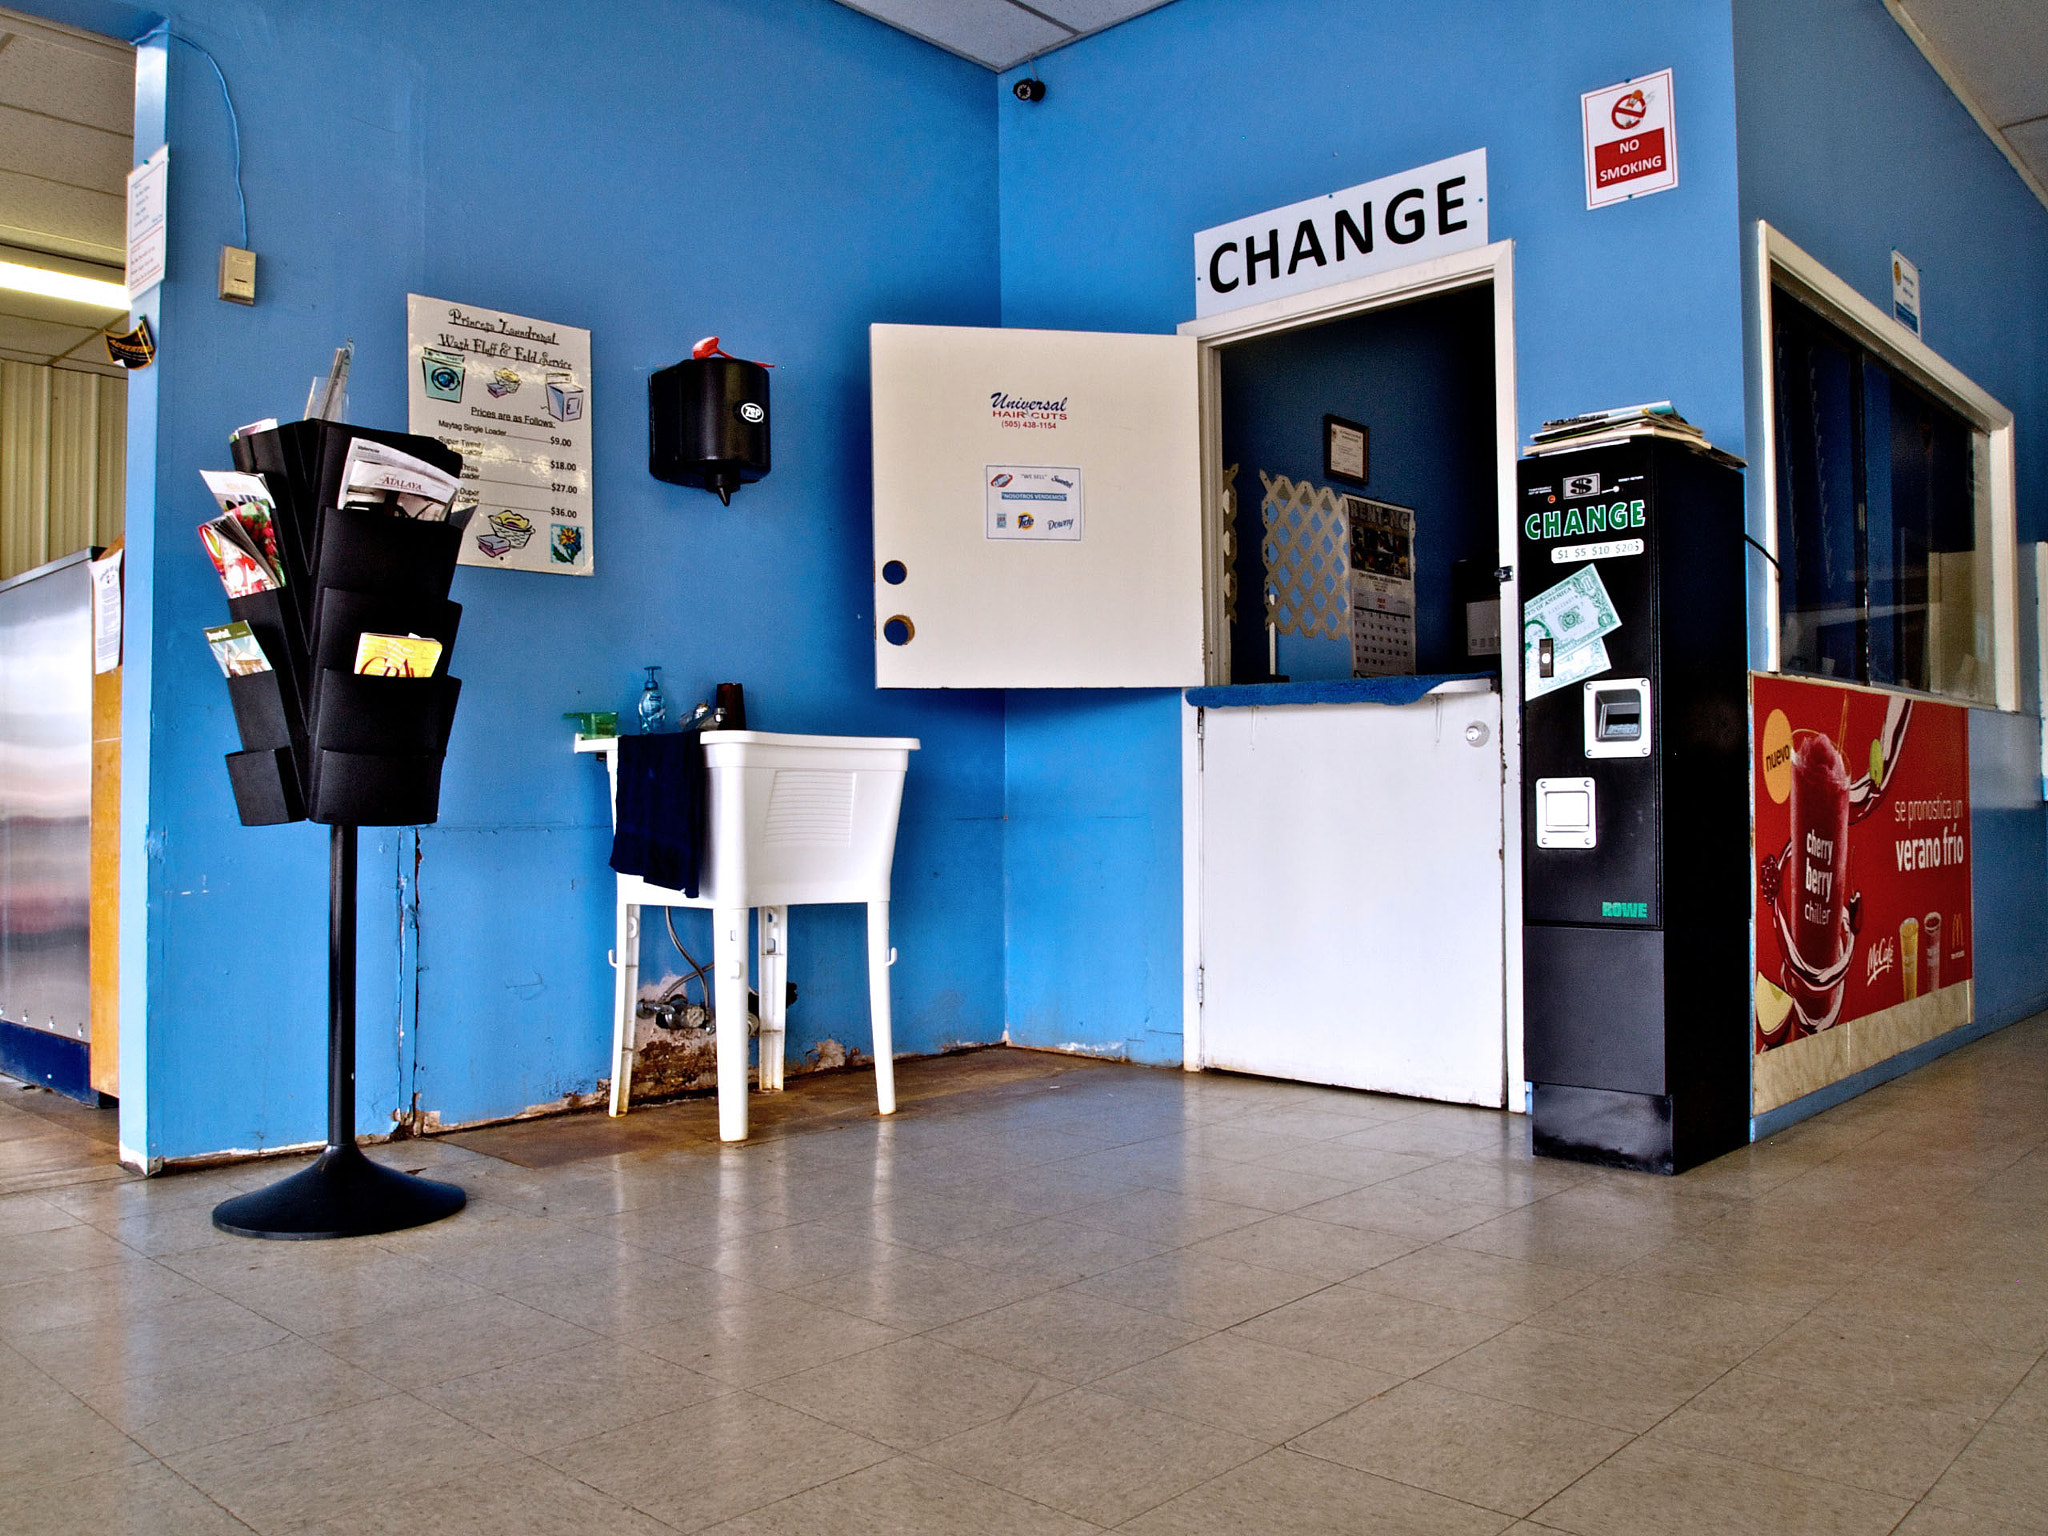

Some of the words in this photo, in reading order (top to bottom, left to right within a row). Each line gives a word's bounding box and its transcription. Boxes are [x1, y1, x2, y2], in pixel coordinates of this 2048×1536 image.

[1619, 139, 1640, 154] NO
[1599, 155, 1662, 182] SMOKING
[1209, 176, 1468, 293] CHANGE
[990, 392, 1067, 411] Universal
[471, 406, 496, 420] Prices
[497, 411, 512, 423] are
[512, 415, 523, 425] as
[523, 415, 556, 429] Follows:
[992, 410, 1025, 419] HAIR
[1030, 411, 1067, 420] CUTS
[438, 420, 463, 432] Maytag
[463, 424, 484, 435] Single
[484, 427, 507, 437] Loader
[549, 436, 572, 448] $9.00
[1001, 420, 1021, 430] (505)
[550, 460, 577, 472] $18.00
[382, 476, 422, 490] ATALAYA
[551, 483, 578, 495] $27.00
[550, 507, 577, 519] $36.00
[1018, 514, 1034, 529] Tide
[1525, 500, 1646, 540] CHANGE
[1047, 518, 1075, 531] Downy
[1557, 549, 1569, 560] $1
[1574, 547, 1587, 558] $5
[1592, 545, 1610, 556] $10
[1766, 744, 1790, 773] nuevo
[1894, 800, 1907, 823] se
[1907, 792, 1952, 830] pronostica
[1952, 798, 1964, 820] un
[1806, 828, 1833, 866] cherry
[1895, 836, 1941, 873] verano
[1942, 822, 1964, 865] frío
[1805, 857, 1833, 903] berry
[1602, 902, 1648, 918] ROWE
[1804, 899, 1831, 925] chiller
